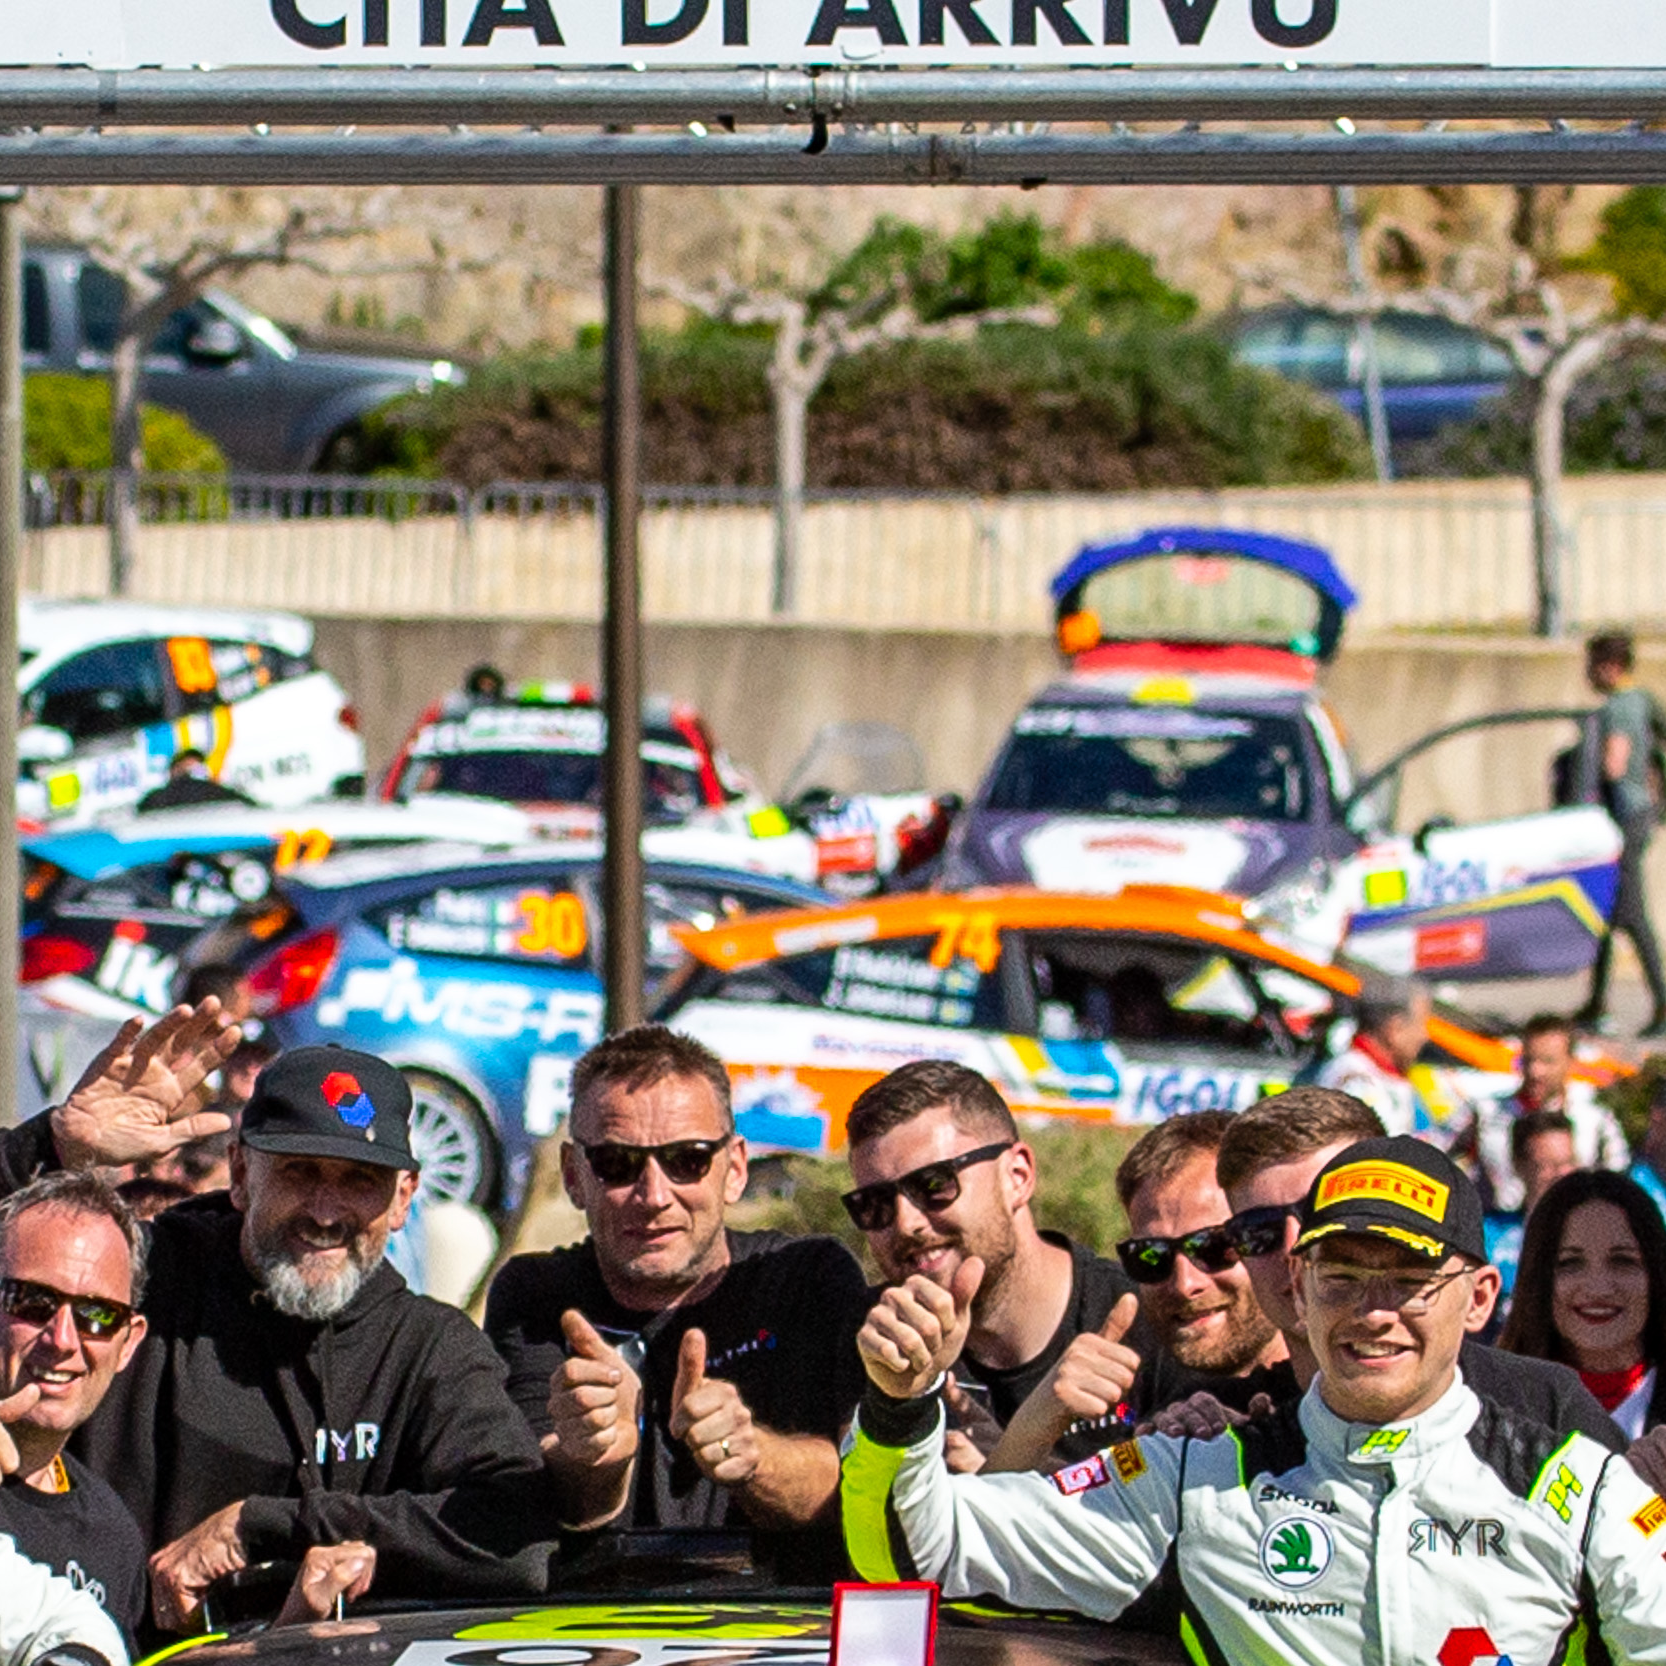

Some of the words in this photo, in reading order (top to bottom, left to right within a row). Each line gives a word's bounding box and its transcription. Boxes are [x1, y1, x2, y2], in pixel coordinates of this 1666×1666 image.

[516, 890, 587, 960] 30
[933, 912, 1002, 973] 74
[1247, 1596, 1346, 1617] RAINWORTH
